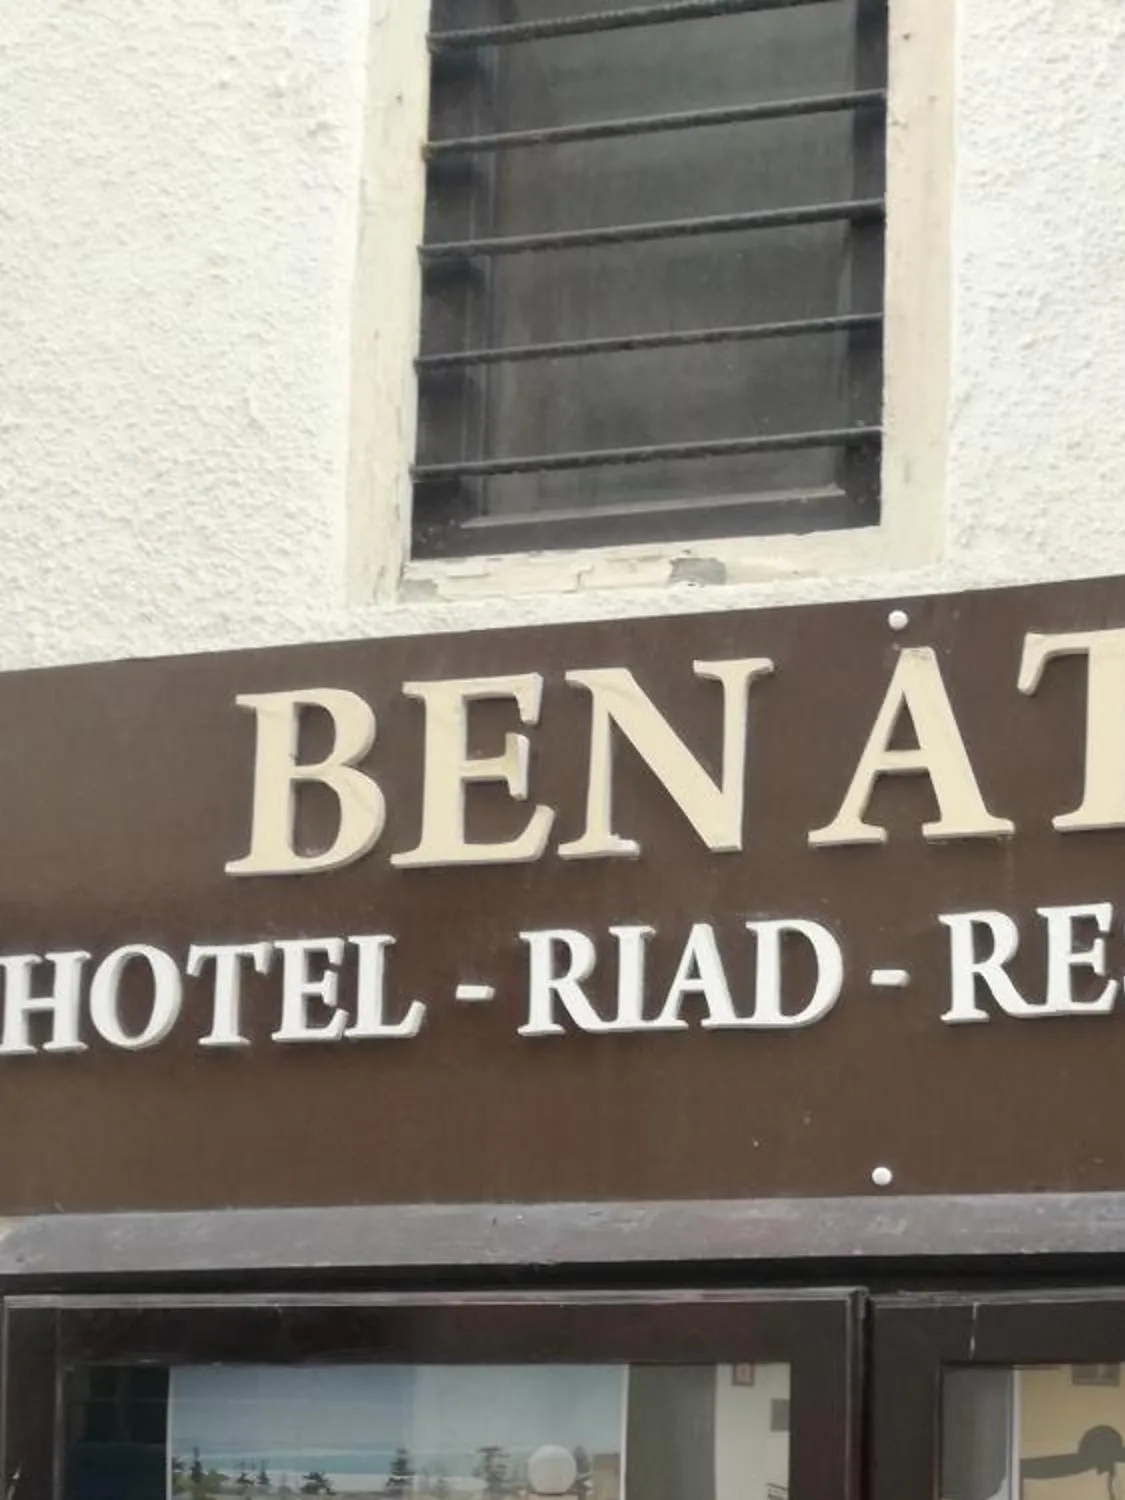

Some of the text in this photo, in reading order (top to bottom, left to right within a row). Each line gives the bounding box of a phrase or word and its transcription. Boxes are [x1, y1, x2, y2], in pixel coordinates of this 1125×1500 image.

[225, 657, 775, 876] BEN
[0, 933, 426, 1055] HOTEL
[517, 917, 845, 1037] RIAD
